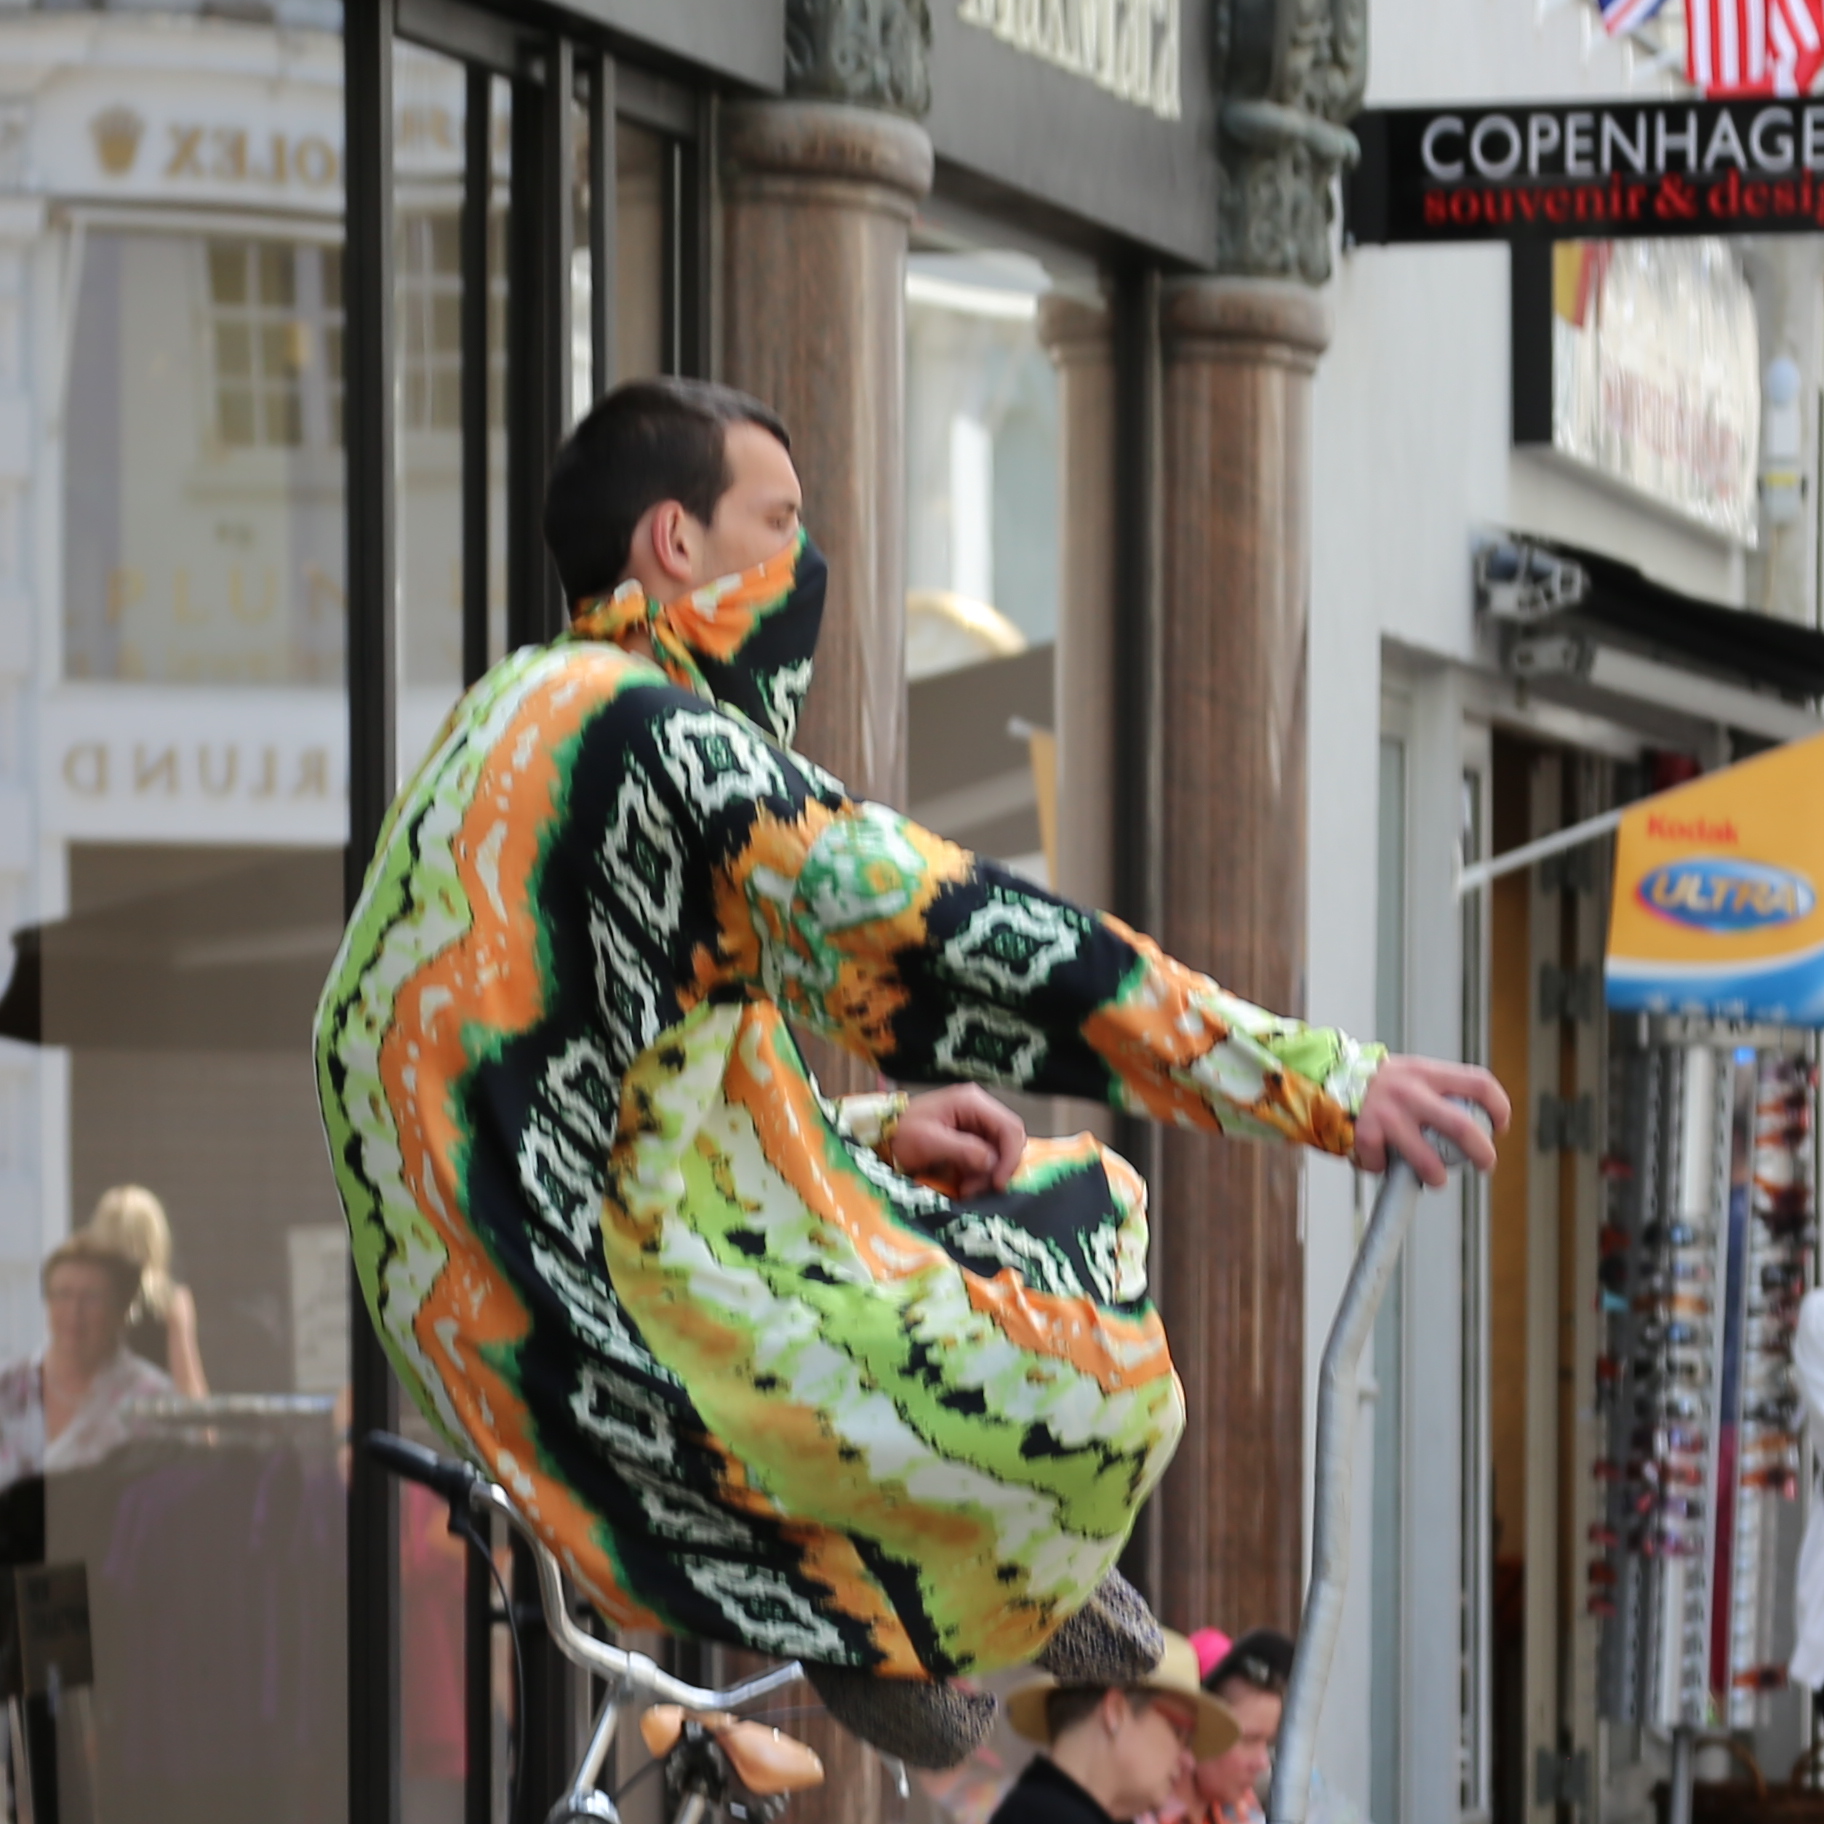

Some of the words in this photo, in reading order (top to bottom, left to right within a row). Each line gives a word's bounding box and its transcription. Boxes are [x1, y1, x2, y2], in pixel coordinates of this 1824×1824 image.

[1423, 170, 1648, 226] souvenir
[1654, 172, 1700, 220] &
[1647, 811, 1740, 846] Kodak
[1649, 870, 1799, 916] ULTRA
